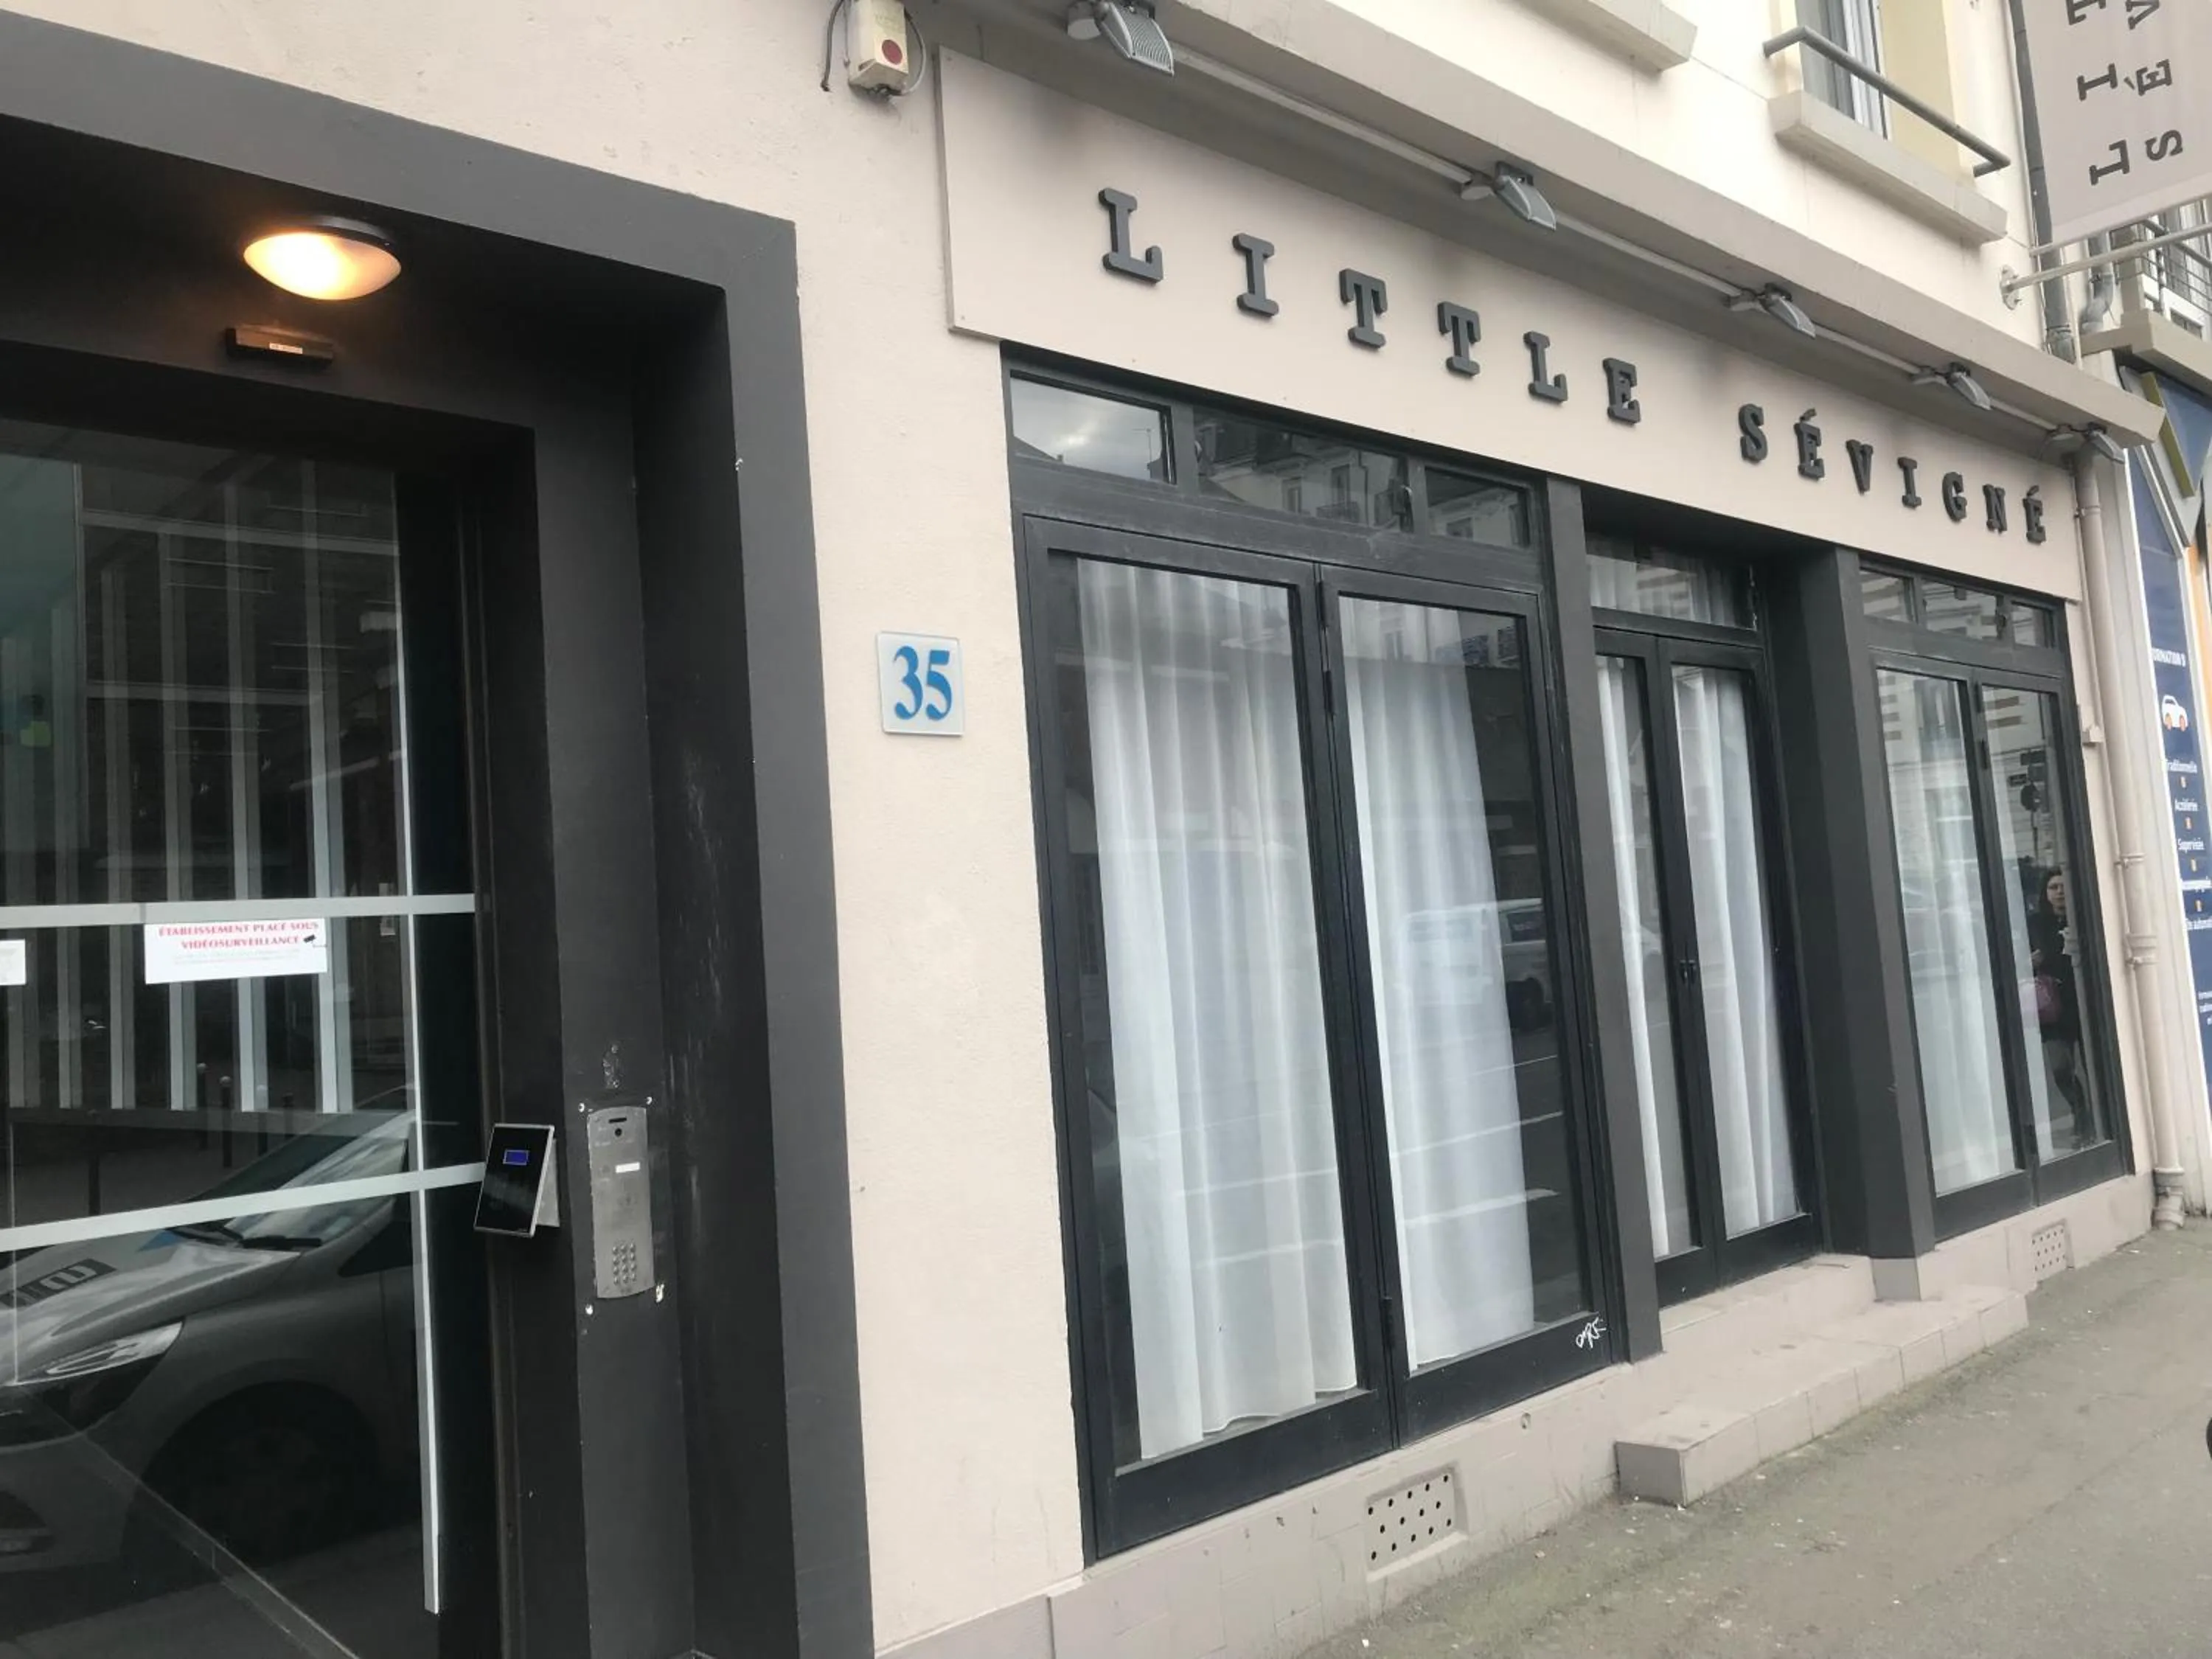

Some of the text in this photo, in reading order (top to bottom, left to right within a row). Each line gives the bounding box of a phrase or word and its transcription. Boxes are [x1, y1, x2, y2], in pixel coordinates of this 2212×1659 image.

[1098, 187, 2048, 545] LITTLE SÉVIGNÉ
[892, 645, 953, 721] 35
[290, 921, 319, 930] SOUS
